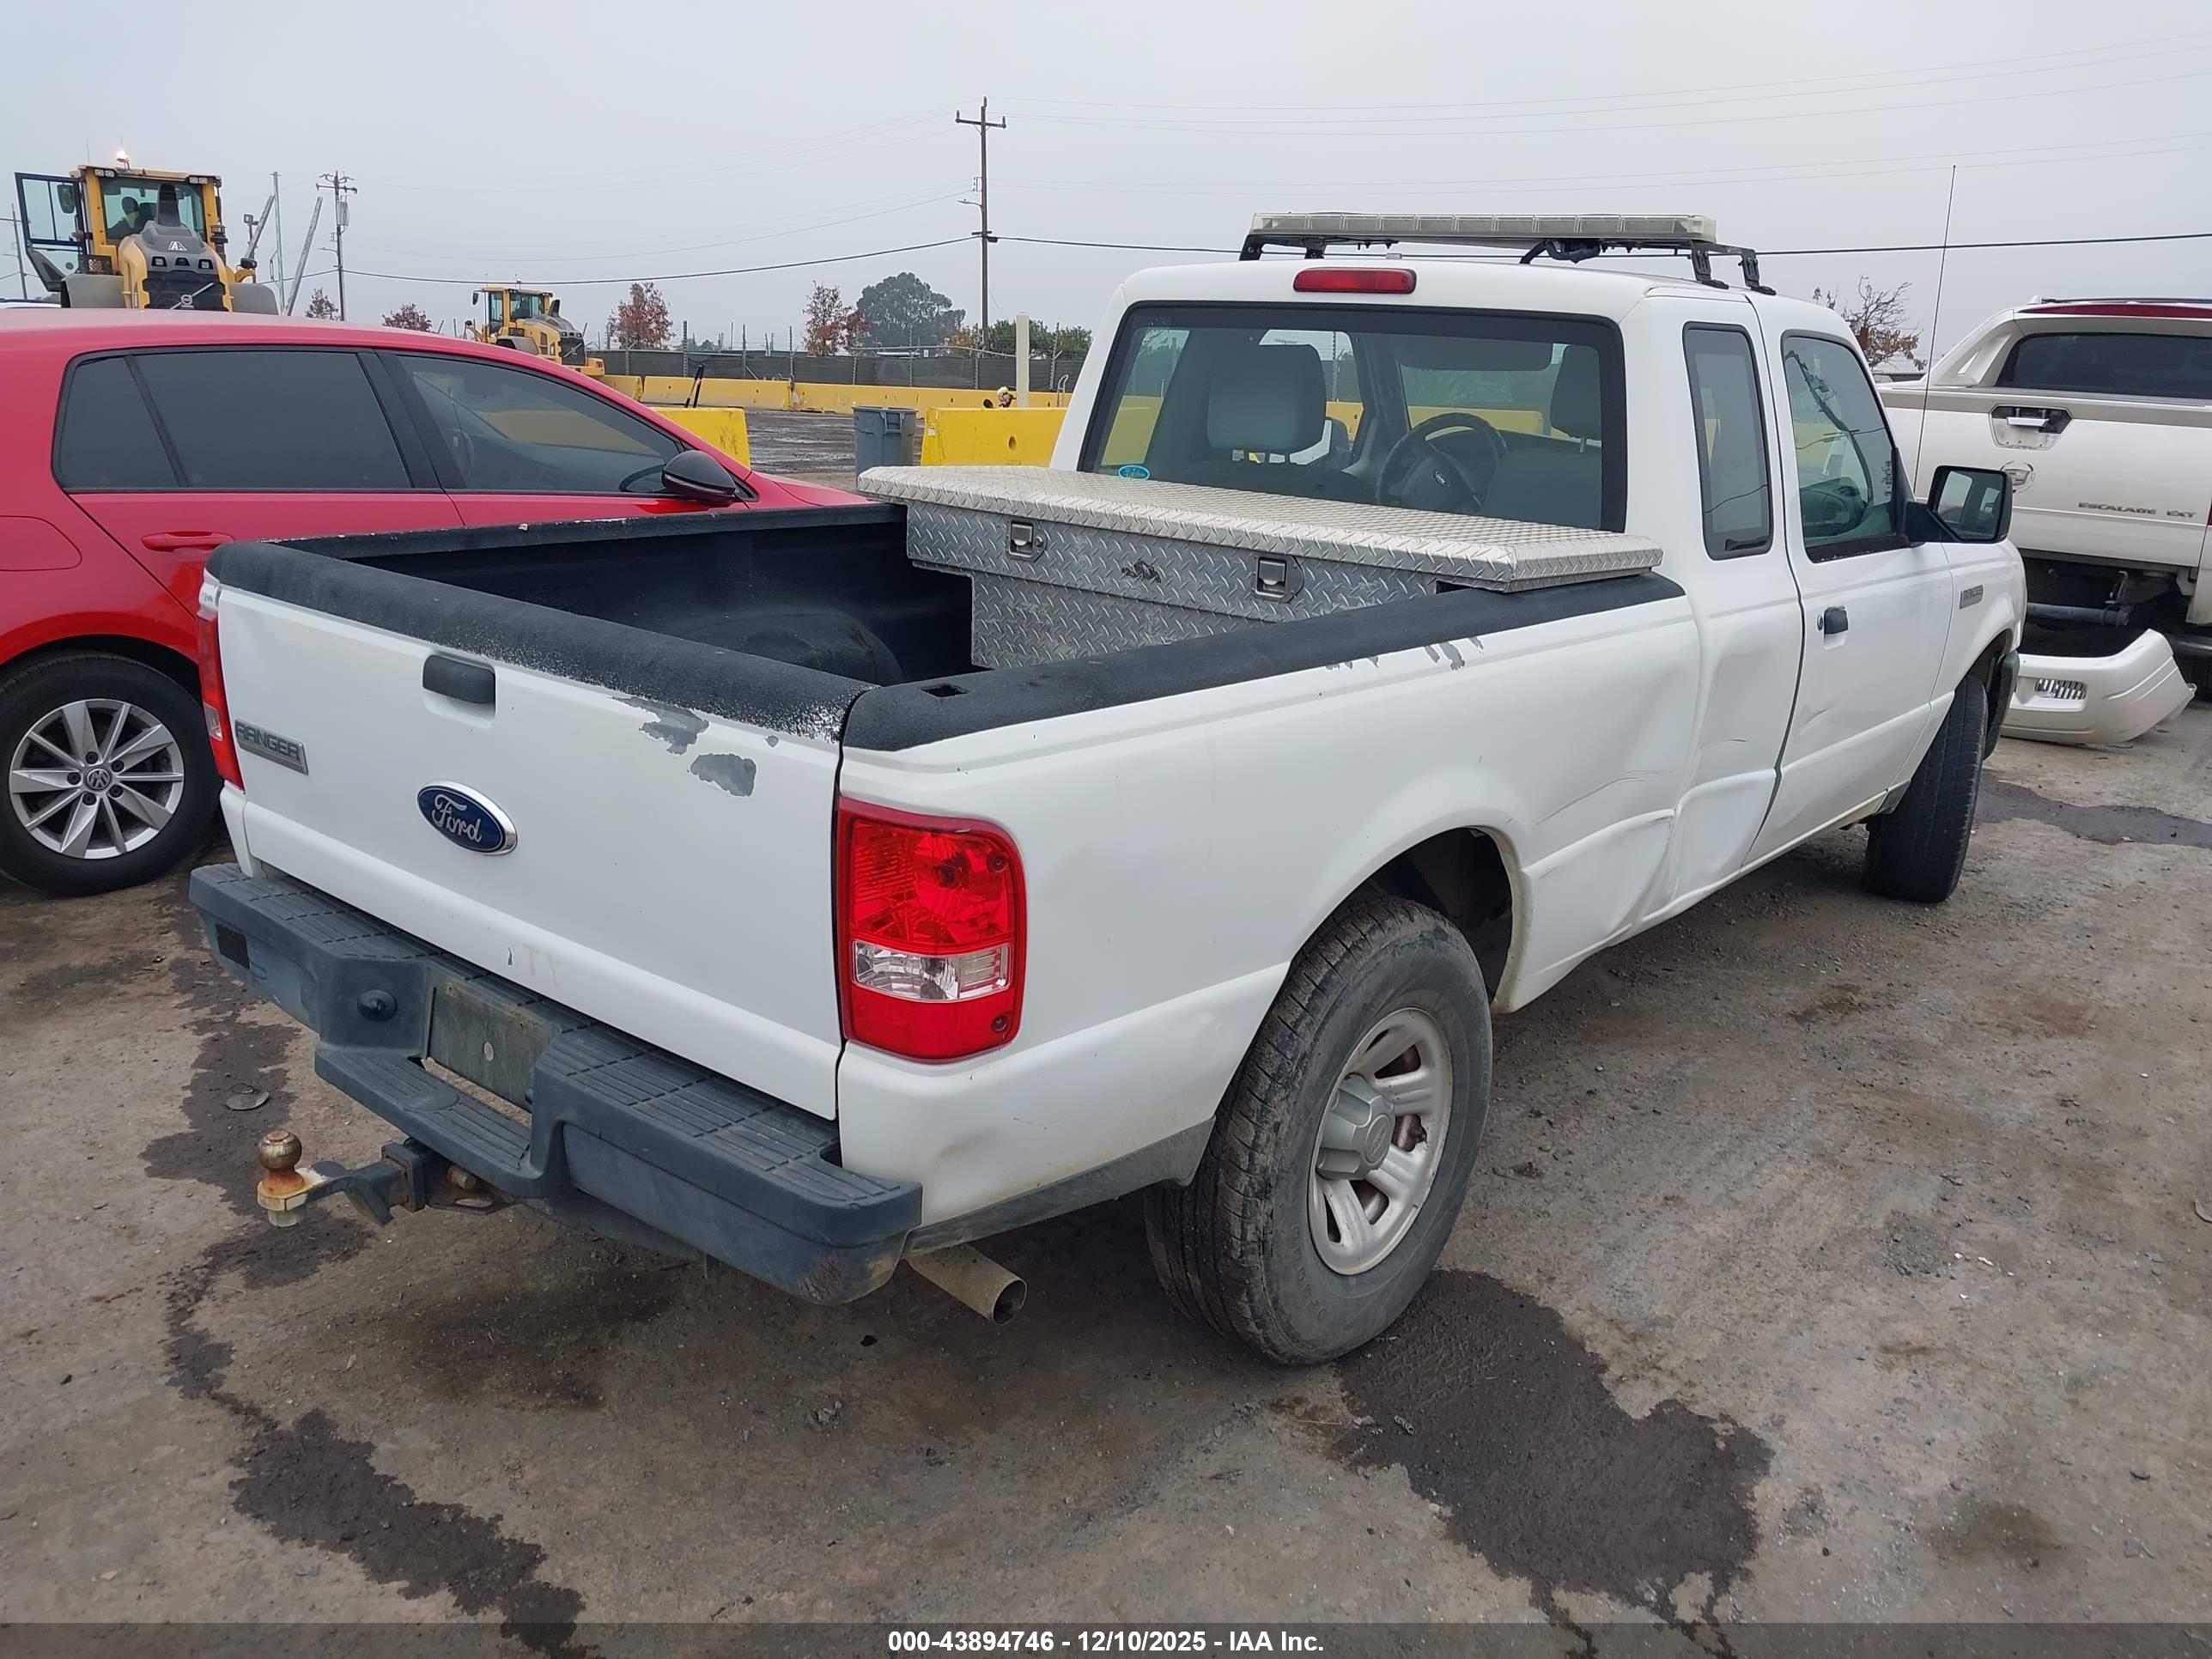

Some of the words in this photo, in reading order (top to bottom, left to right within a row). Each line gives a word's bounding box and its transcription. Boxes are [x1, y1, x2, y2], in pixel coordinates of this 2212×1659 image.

[2078, 501, 2157, 515] ESCALADE
[2166, 508, 2197, 519] EXT
[234, 720, 300, 762] RANGER
[432, 793, 483, 843] Ford
